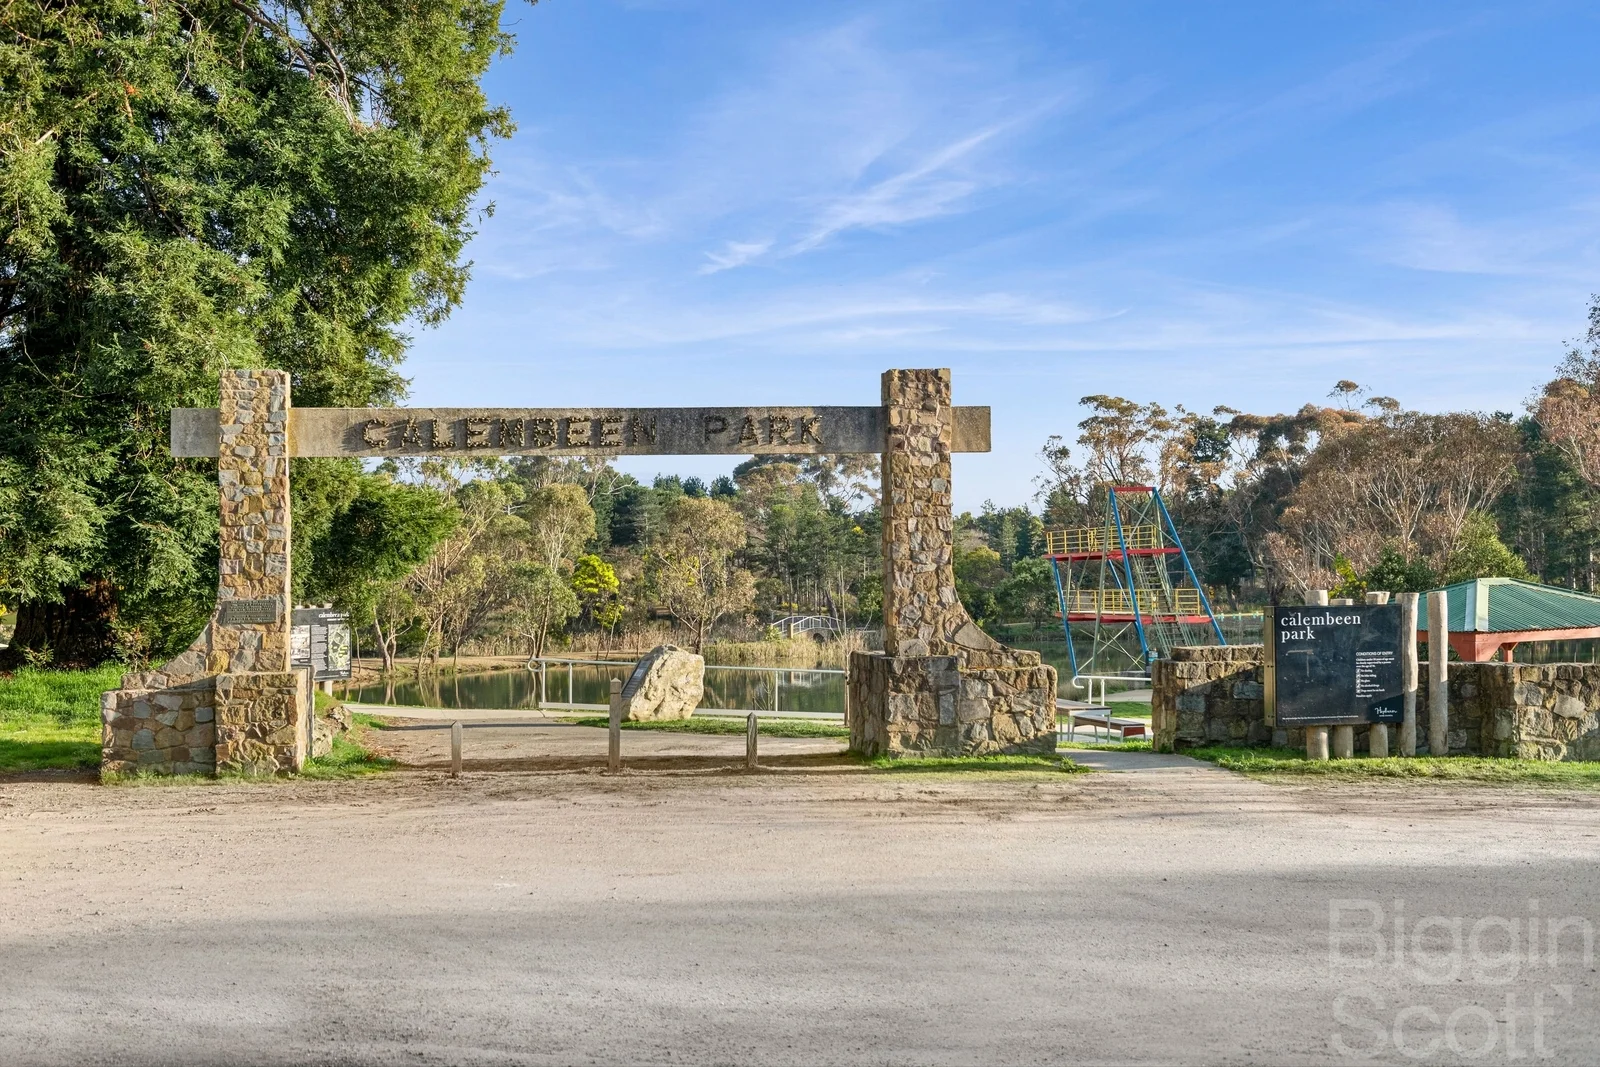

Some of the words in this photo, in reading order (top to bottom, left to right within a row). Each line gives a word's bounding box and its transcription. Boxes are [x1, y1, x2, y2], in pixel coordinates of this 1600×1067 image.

[362, 415, 656, 448] CALEMBEEN
[703, 413, 824, 446] PARK
[1281, 626, 1316, 643] park
